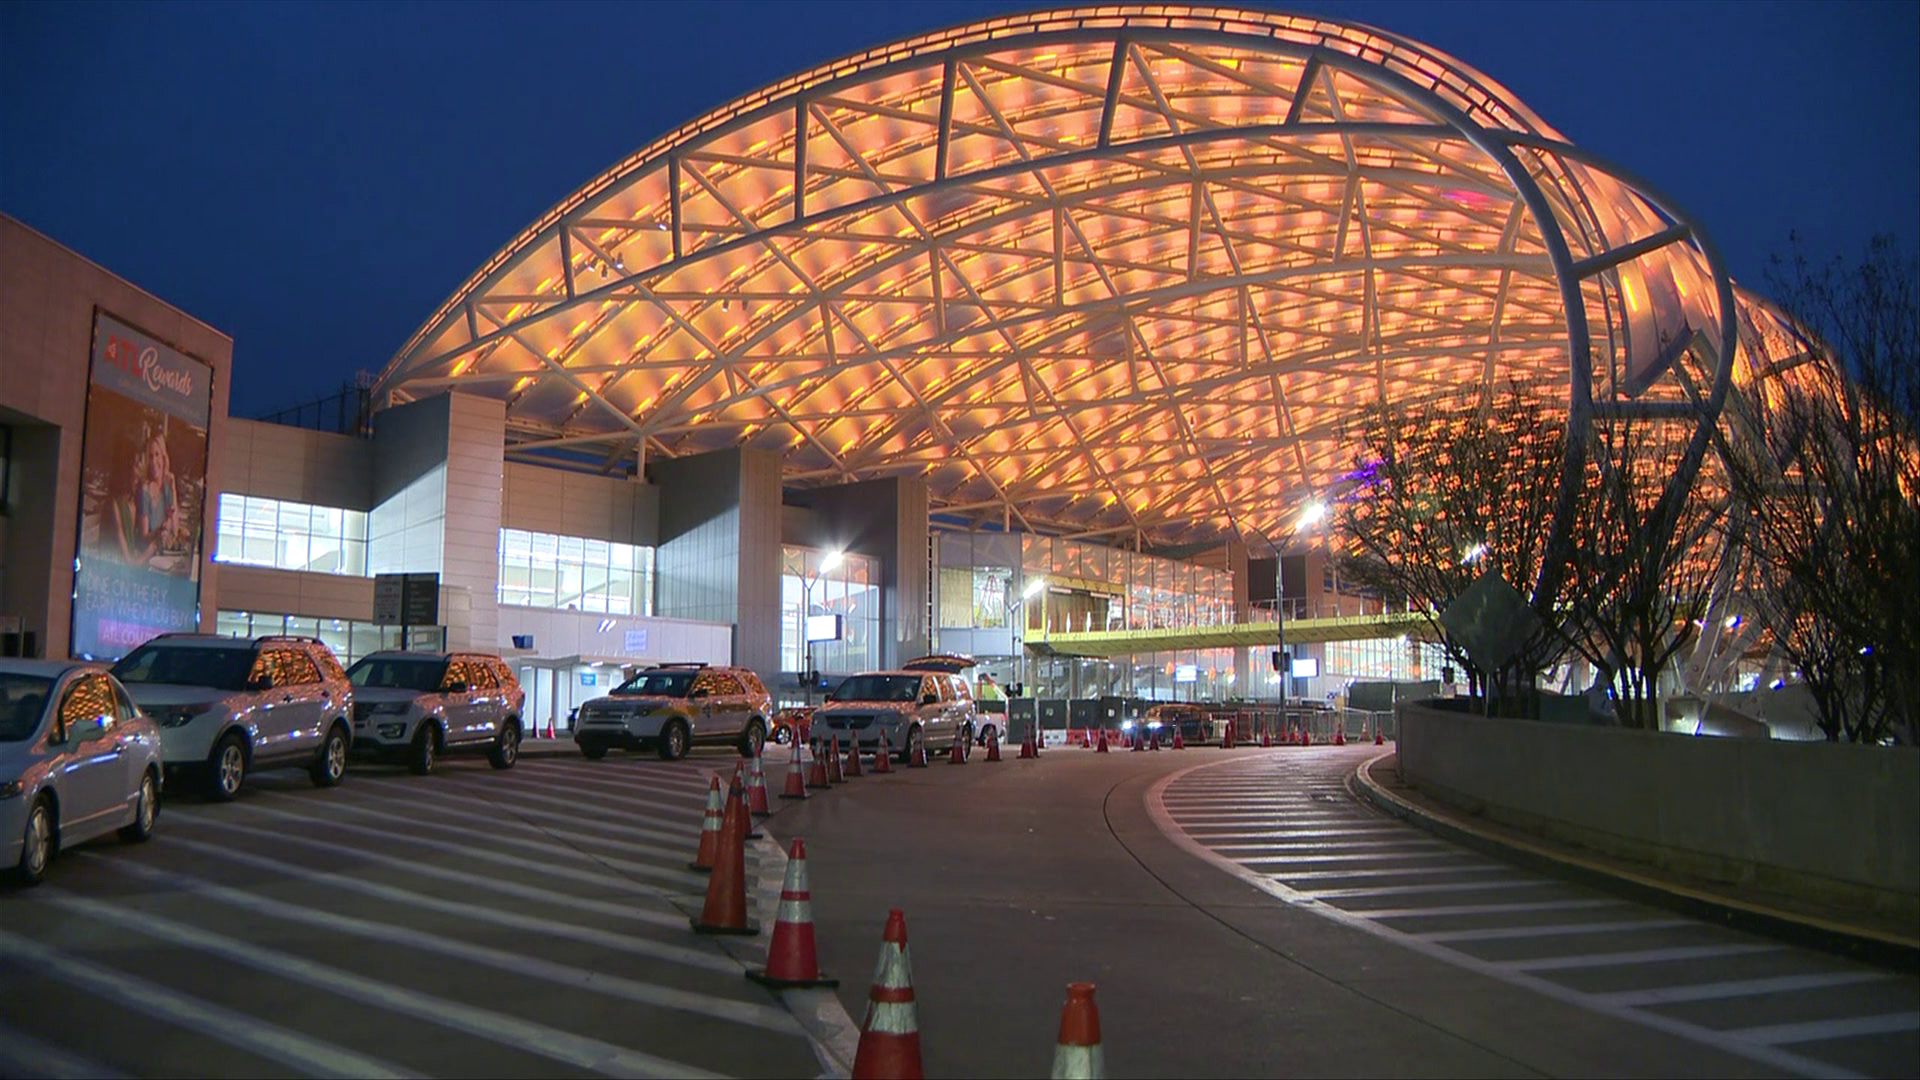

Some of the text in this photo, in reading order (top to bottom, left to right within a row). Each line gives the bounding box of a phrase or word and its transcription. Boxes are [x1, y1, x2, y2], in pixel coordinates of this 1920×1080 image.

[104, 335, 193, 396] ATL Rewards
[86, 574, 169, 605] DINE ON THE FLY
[116, 598, 147, 620] WHEN
[150, 605, 169, 625] YOU
[171, 609, 189, 627] BUY
